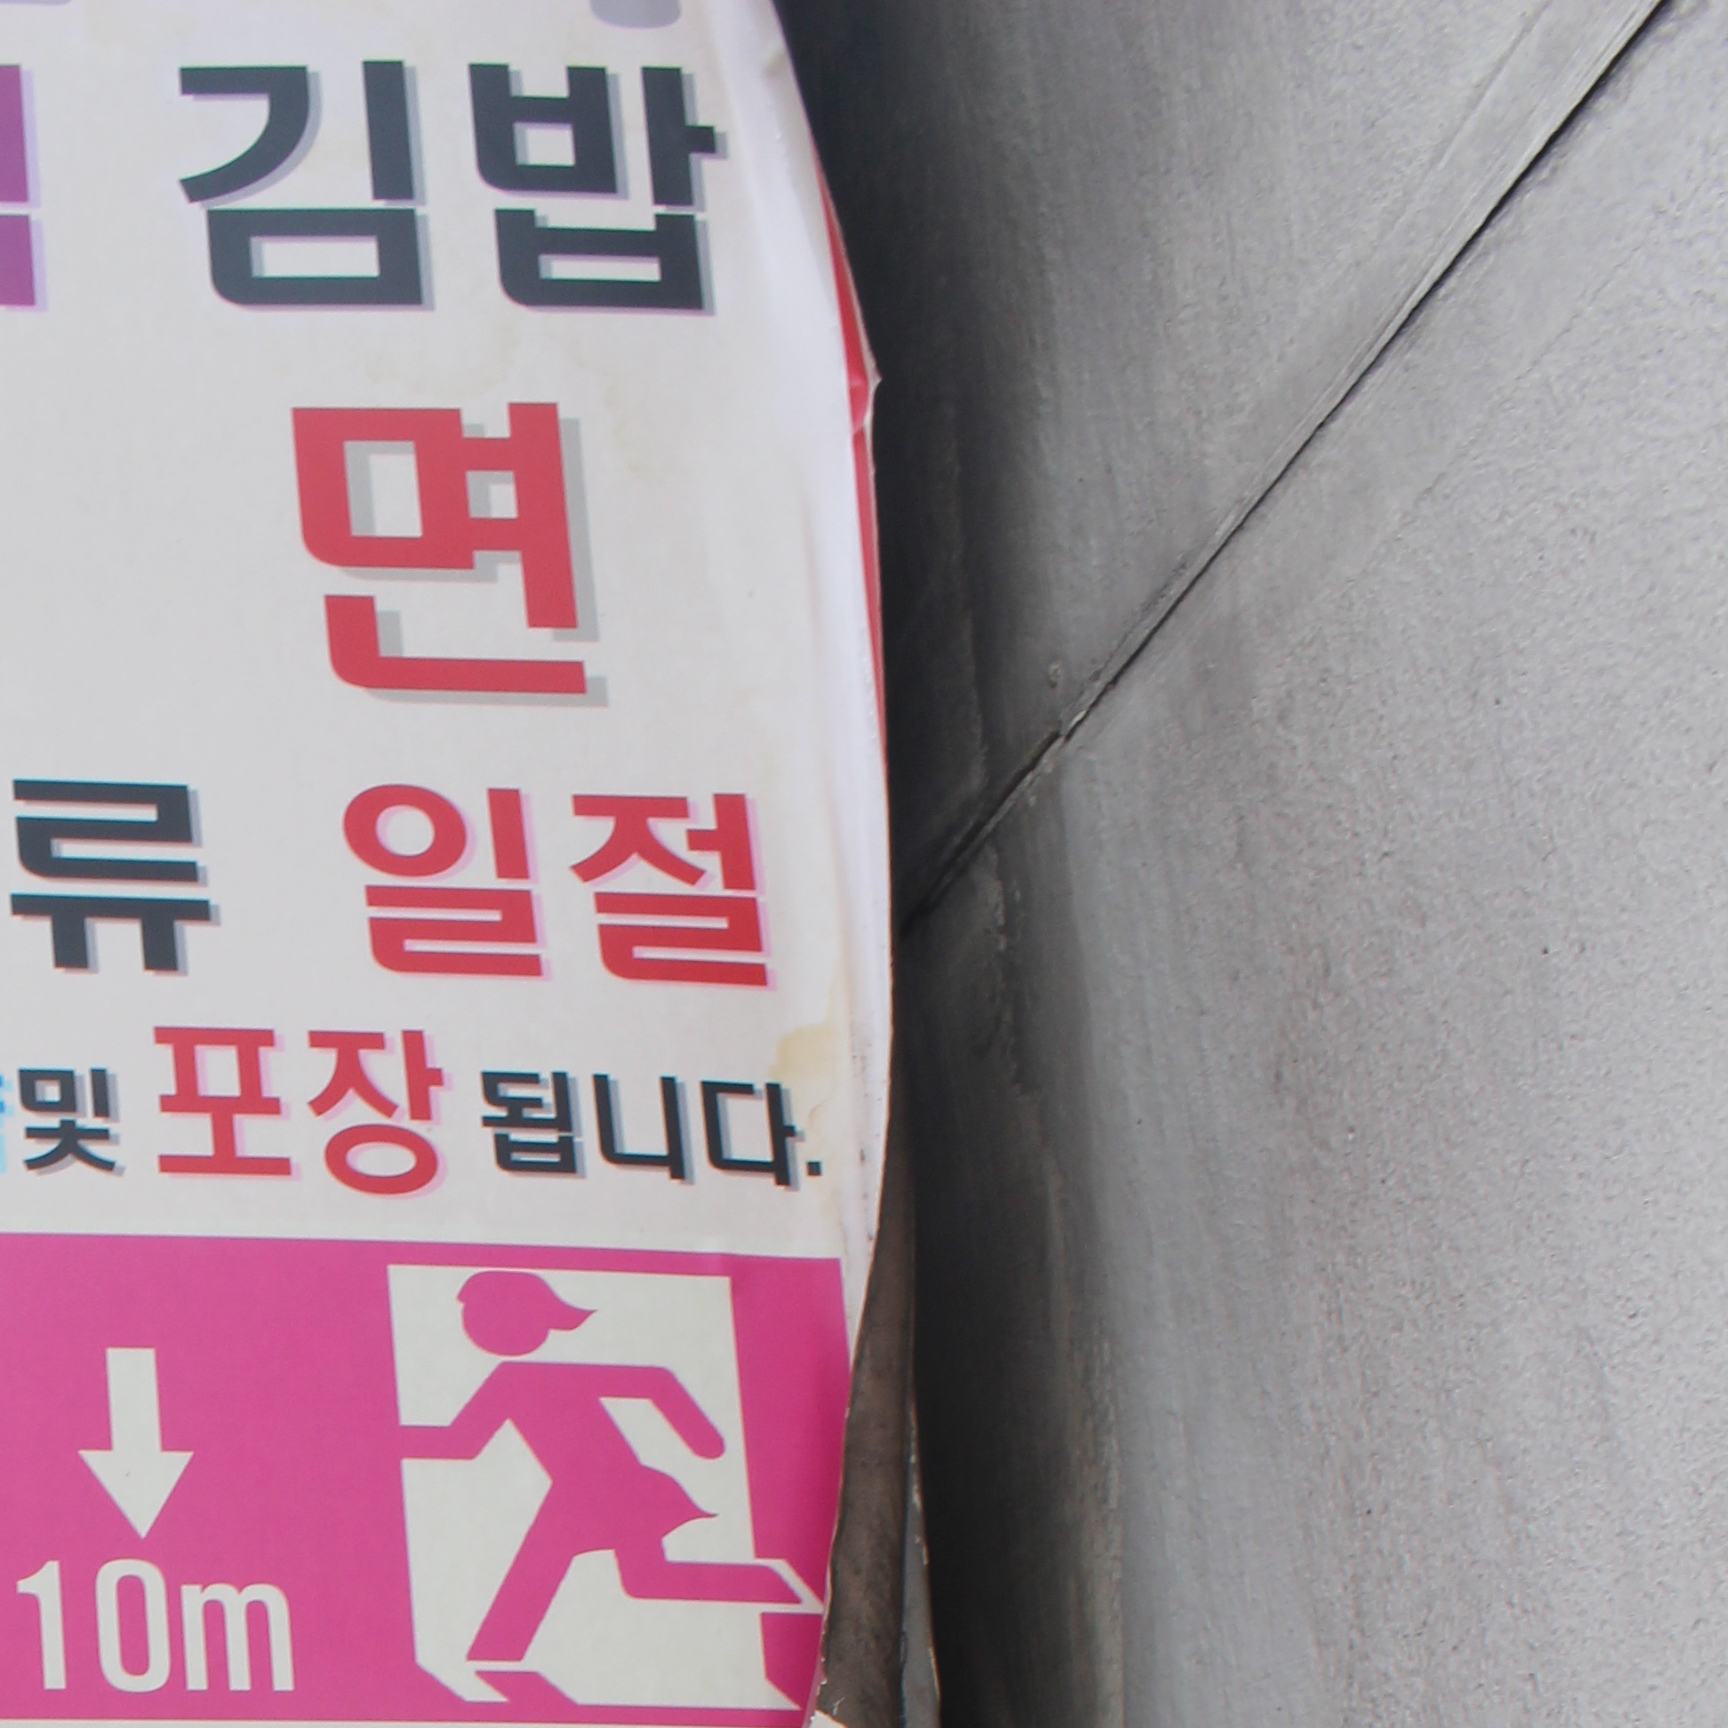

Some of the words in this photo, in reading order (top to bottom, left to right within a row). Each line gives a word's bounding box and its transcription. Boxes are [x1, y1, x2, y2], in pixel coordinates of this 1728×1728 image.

[178, 58, 718, 311] 김밥
[342, 783, 770, 987] 일절
[153, 1026, 443, 1194] 포장
[481, 1071, 822, 1186] 됩니다.
[15, 1558, 296, 1694] 10m
